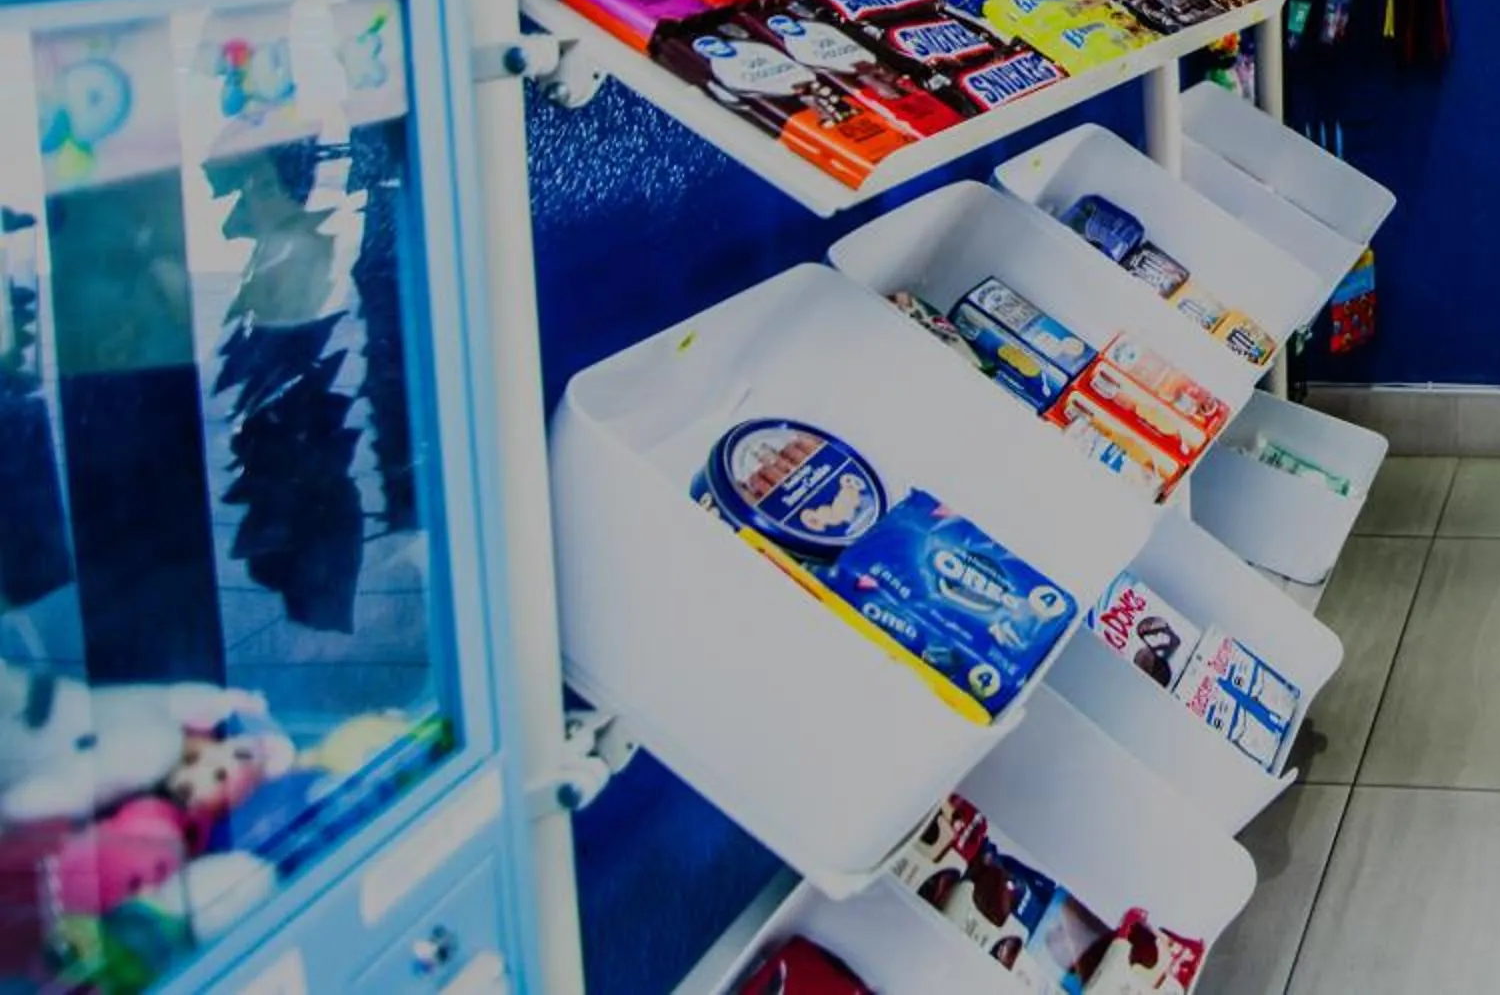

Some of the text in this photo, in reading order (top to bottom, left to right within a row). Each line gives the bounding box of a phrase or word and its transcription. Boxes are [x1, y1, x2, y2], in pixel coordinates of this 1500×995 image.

[968, 52, 1059, 105] SNICKERS
[933, 549, 1021, 610] OREO
[861, 601, 919, 640] OREO
